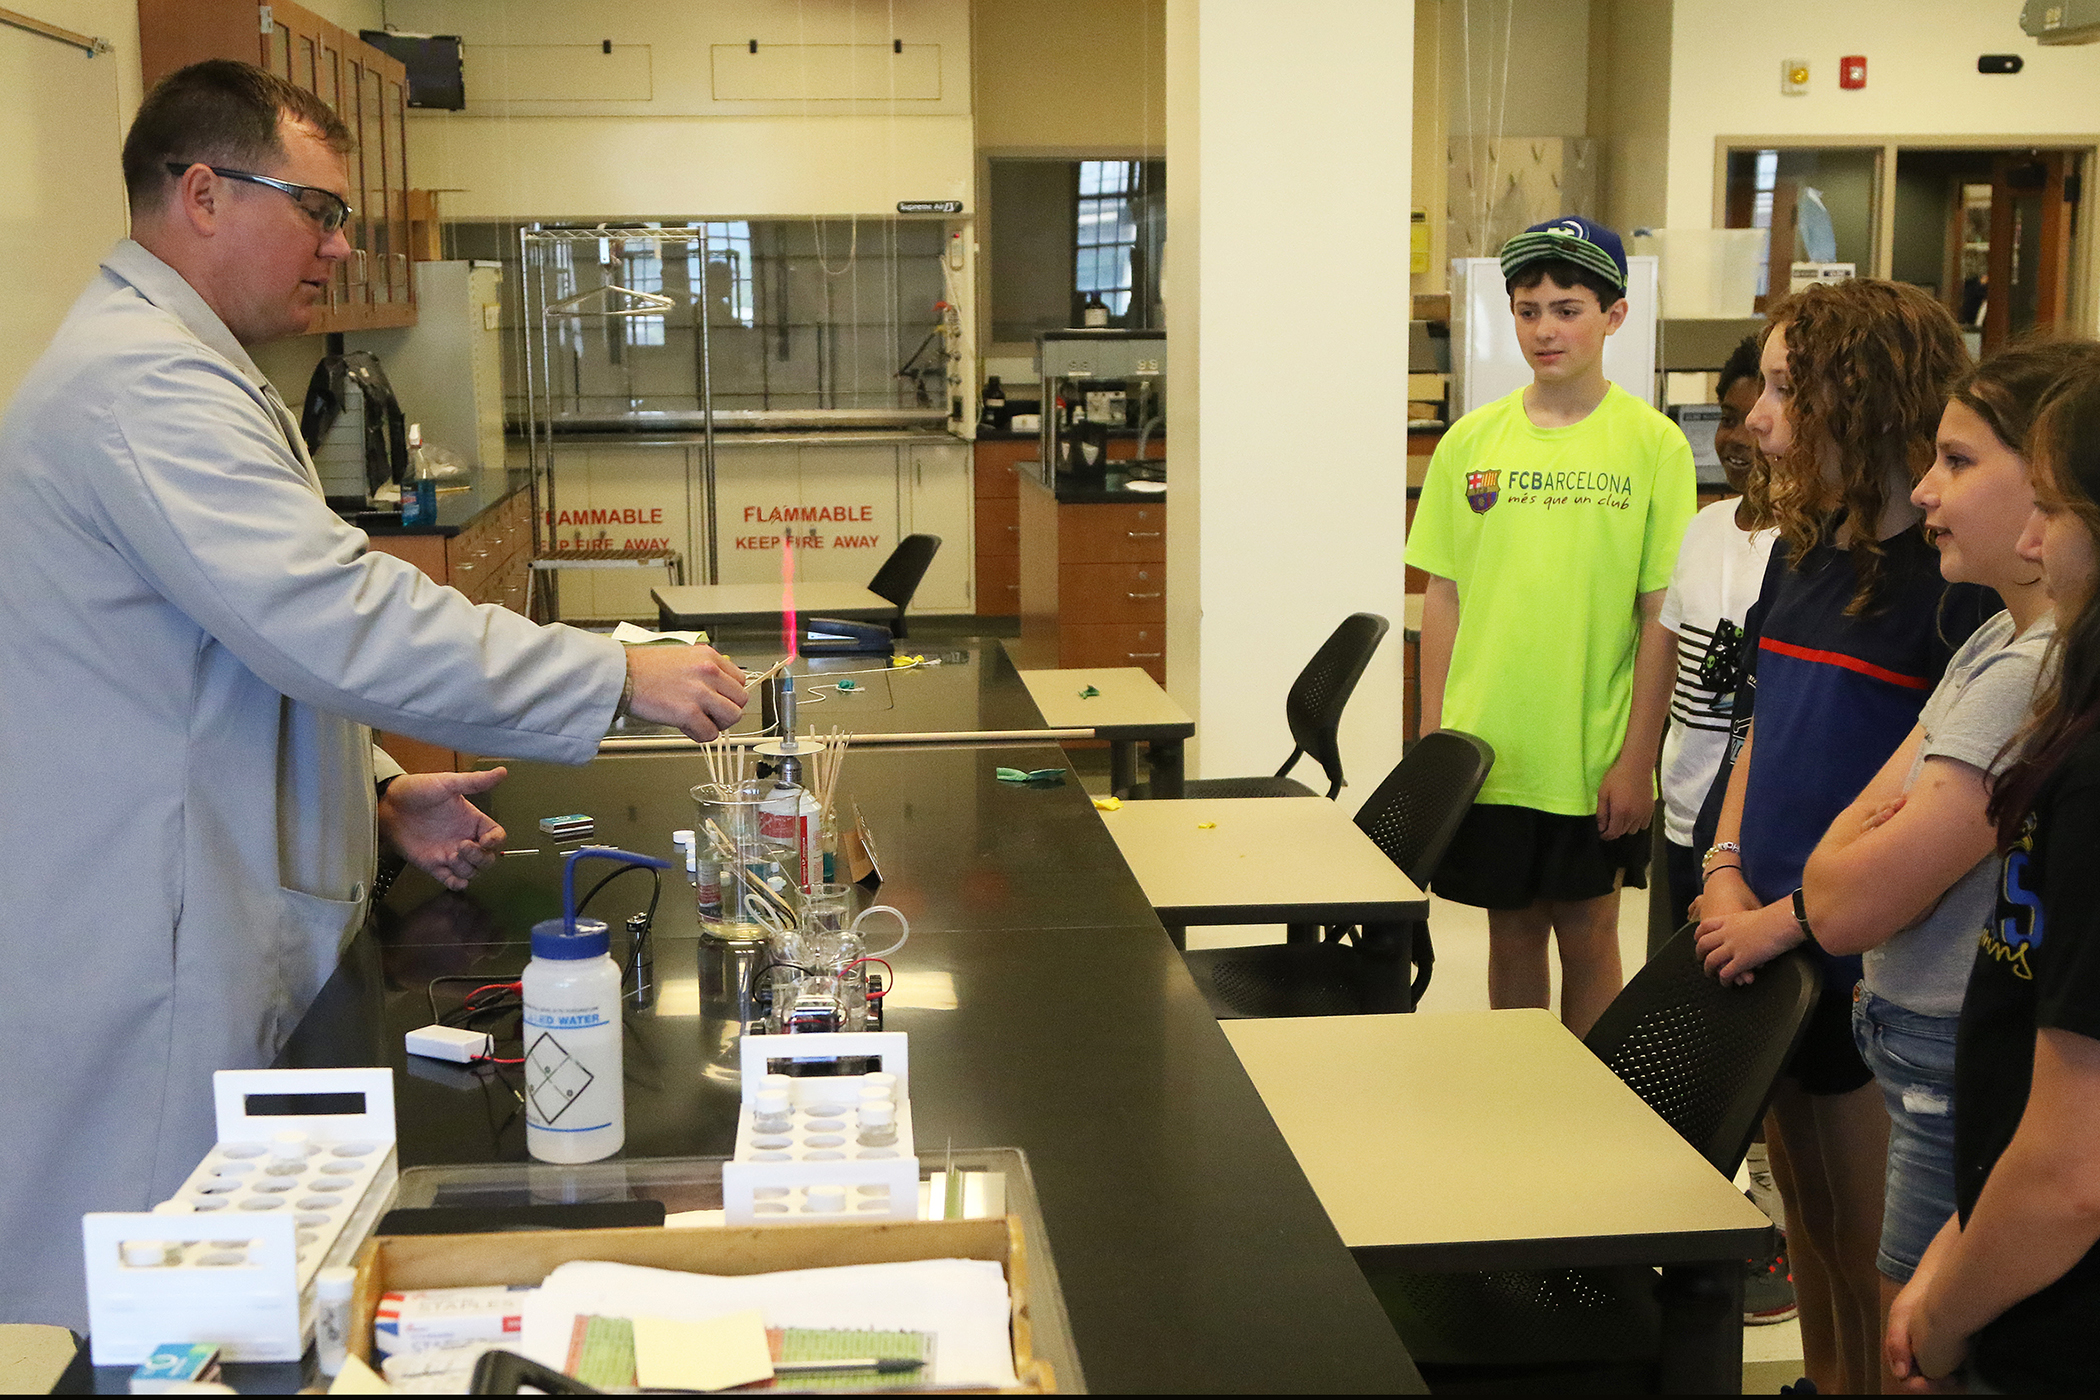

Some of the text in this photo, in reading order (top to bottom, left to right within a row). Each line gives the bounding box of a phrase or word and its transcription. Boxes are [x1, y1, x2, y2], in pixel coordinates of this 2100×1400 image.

[1508, 493, 1537, 504] més
[1544, 496, 1568, 510] que
[1597, 493, 1629, 510] club
[743, 505, 873, 523] FLAMMABLE
[624, 538, 670, 550] AWAY
[735, 535, 879, 549] KEEP FIRE AWAY
[559, 1013, 600, 1025] WATER
